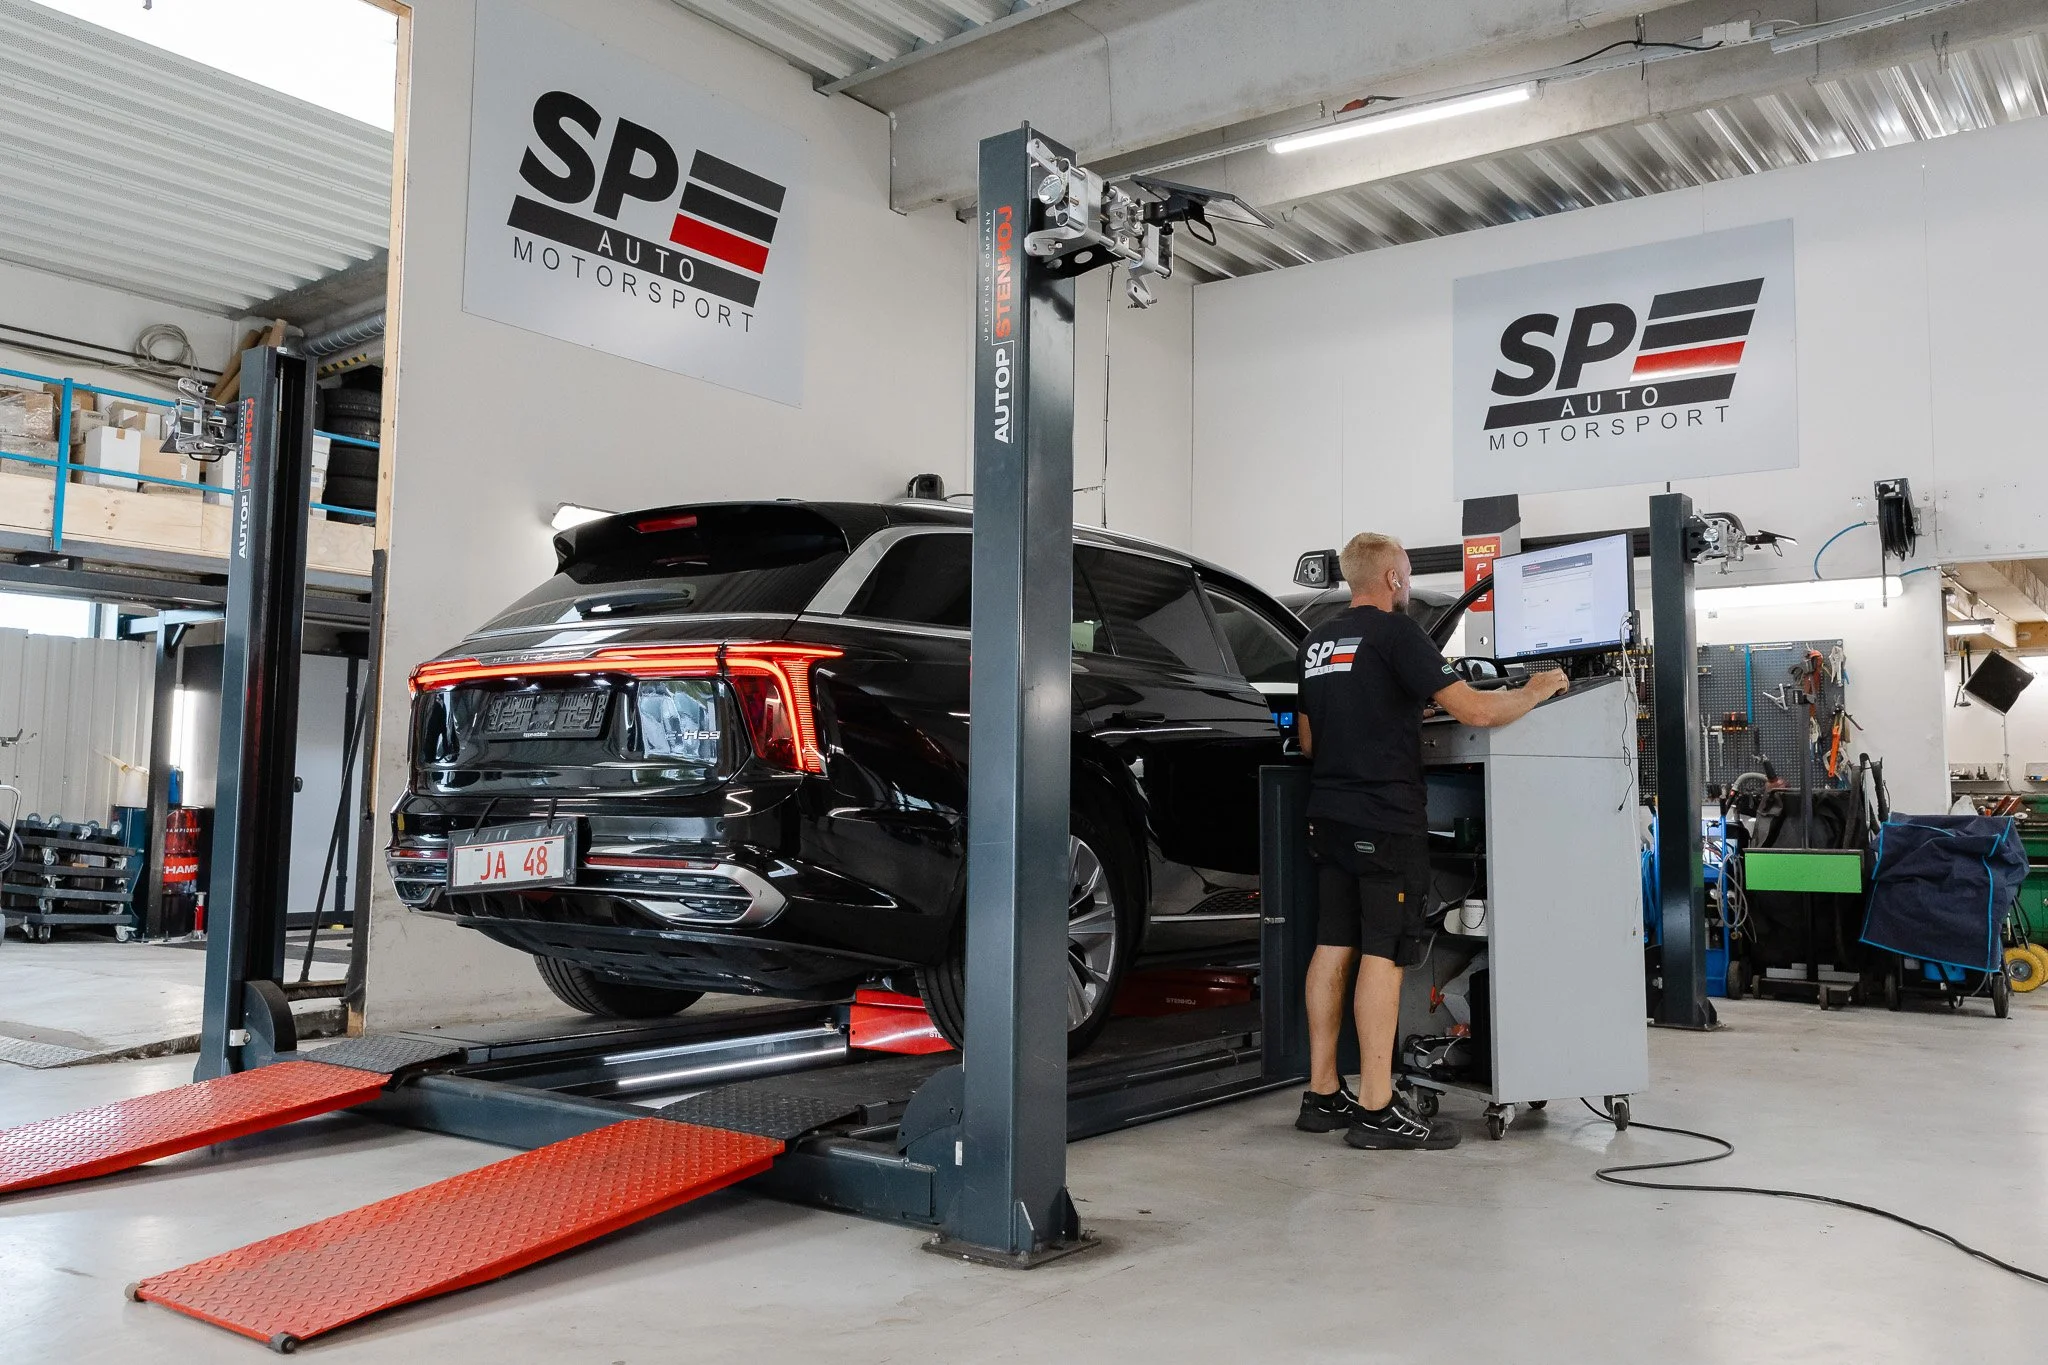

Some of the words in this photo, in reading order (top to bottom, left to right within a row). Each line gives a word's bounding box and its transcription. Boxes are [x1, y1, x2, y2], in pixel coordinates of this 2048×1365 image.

[518, 90, 679, 221] SP
[513, 236, 754, 333] MOTORSPORT
[597, 230, 695, 283] AUTO
[995, 204, 1013, 339] STENHOJ
[1490, 302, 1638, 397] SP
[994, 348, 1010, 444] AUTOP
[1560, 386, 1659, 418] AUTO
[241, 397, 255, 488] STENHOJ
[1489, 405, 1730, 451] MOTORSPORT
[238, 495, 251, 559] AUTOP
[1466, 544, 1497, 555] EXACT
[1304, 640, 1335, 669] SP
[162, 864, 199, 874] HAMP
[480, 850, 507, 881] JA
[523, 845, 548, 877] 48
